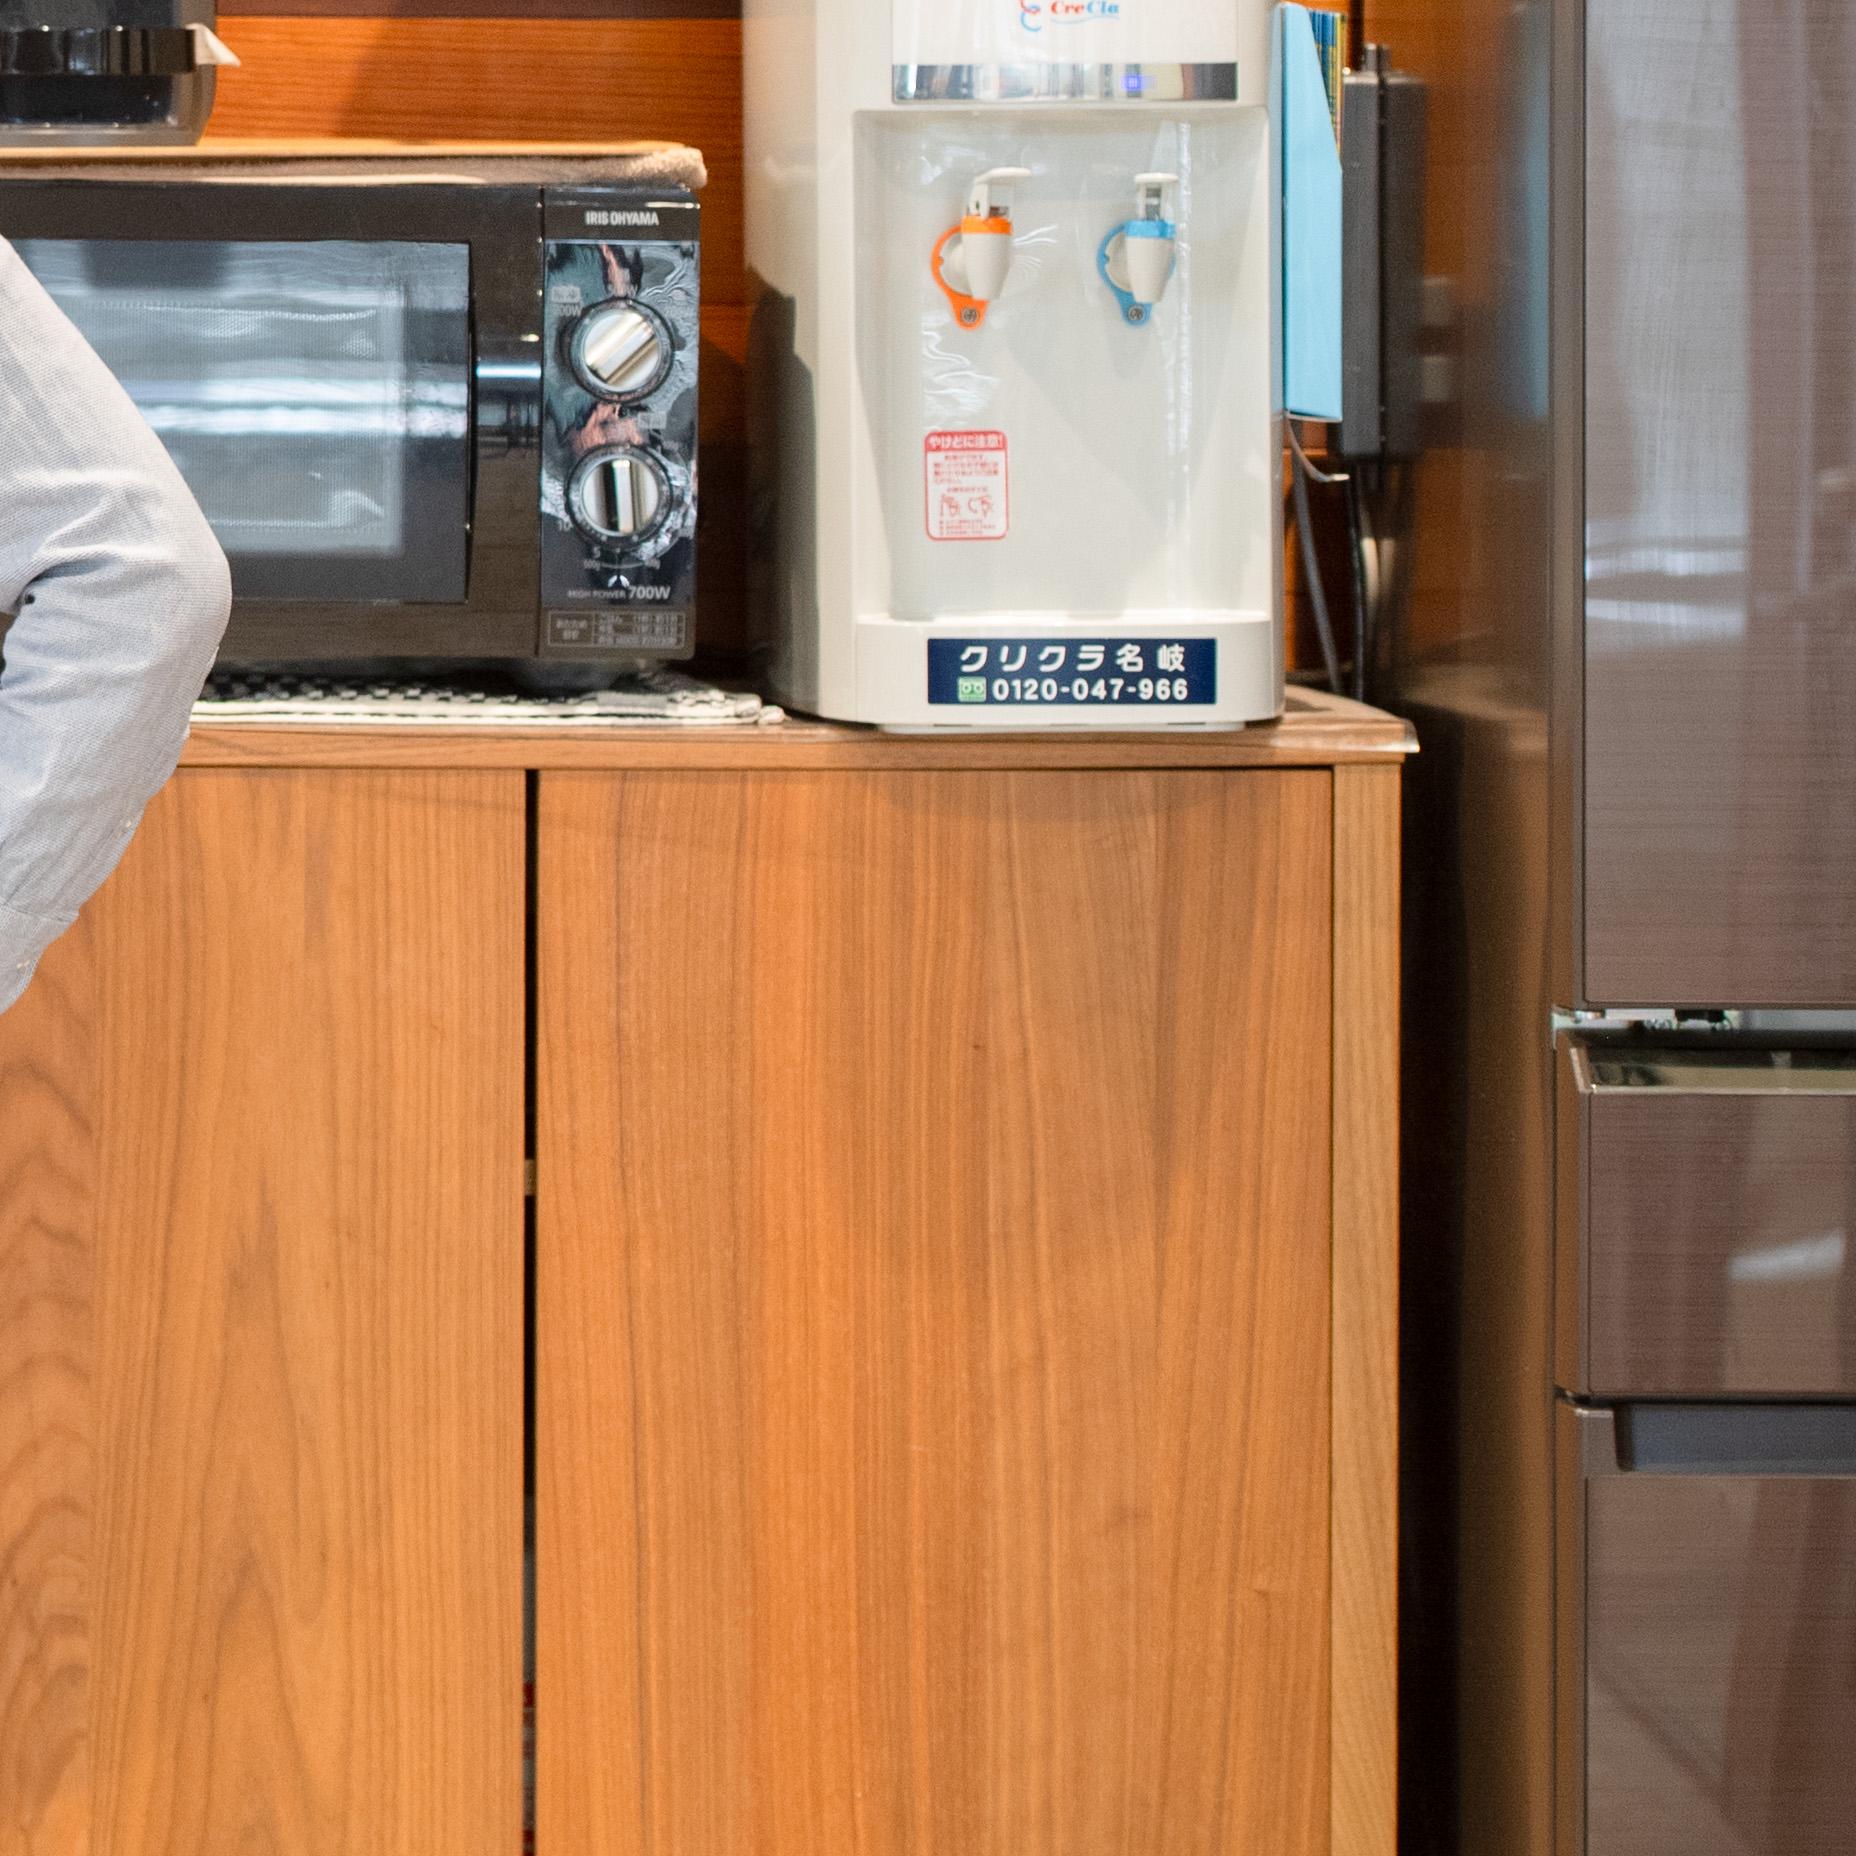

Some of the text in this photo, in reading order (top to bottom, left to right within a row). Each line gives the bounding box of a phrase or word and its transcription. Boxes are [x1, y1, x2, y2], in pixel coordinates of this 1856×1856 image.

[585, 211, 660, 226] IRIS OHYAMA
[629, 586, 671, 600] 700W
[959, 643, 1185, 673] クリクラ名岐
[991, 677, 1189, 701] 0120-047-966
